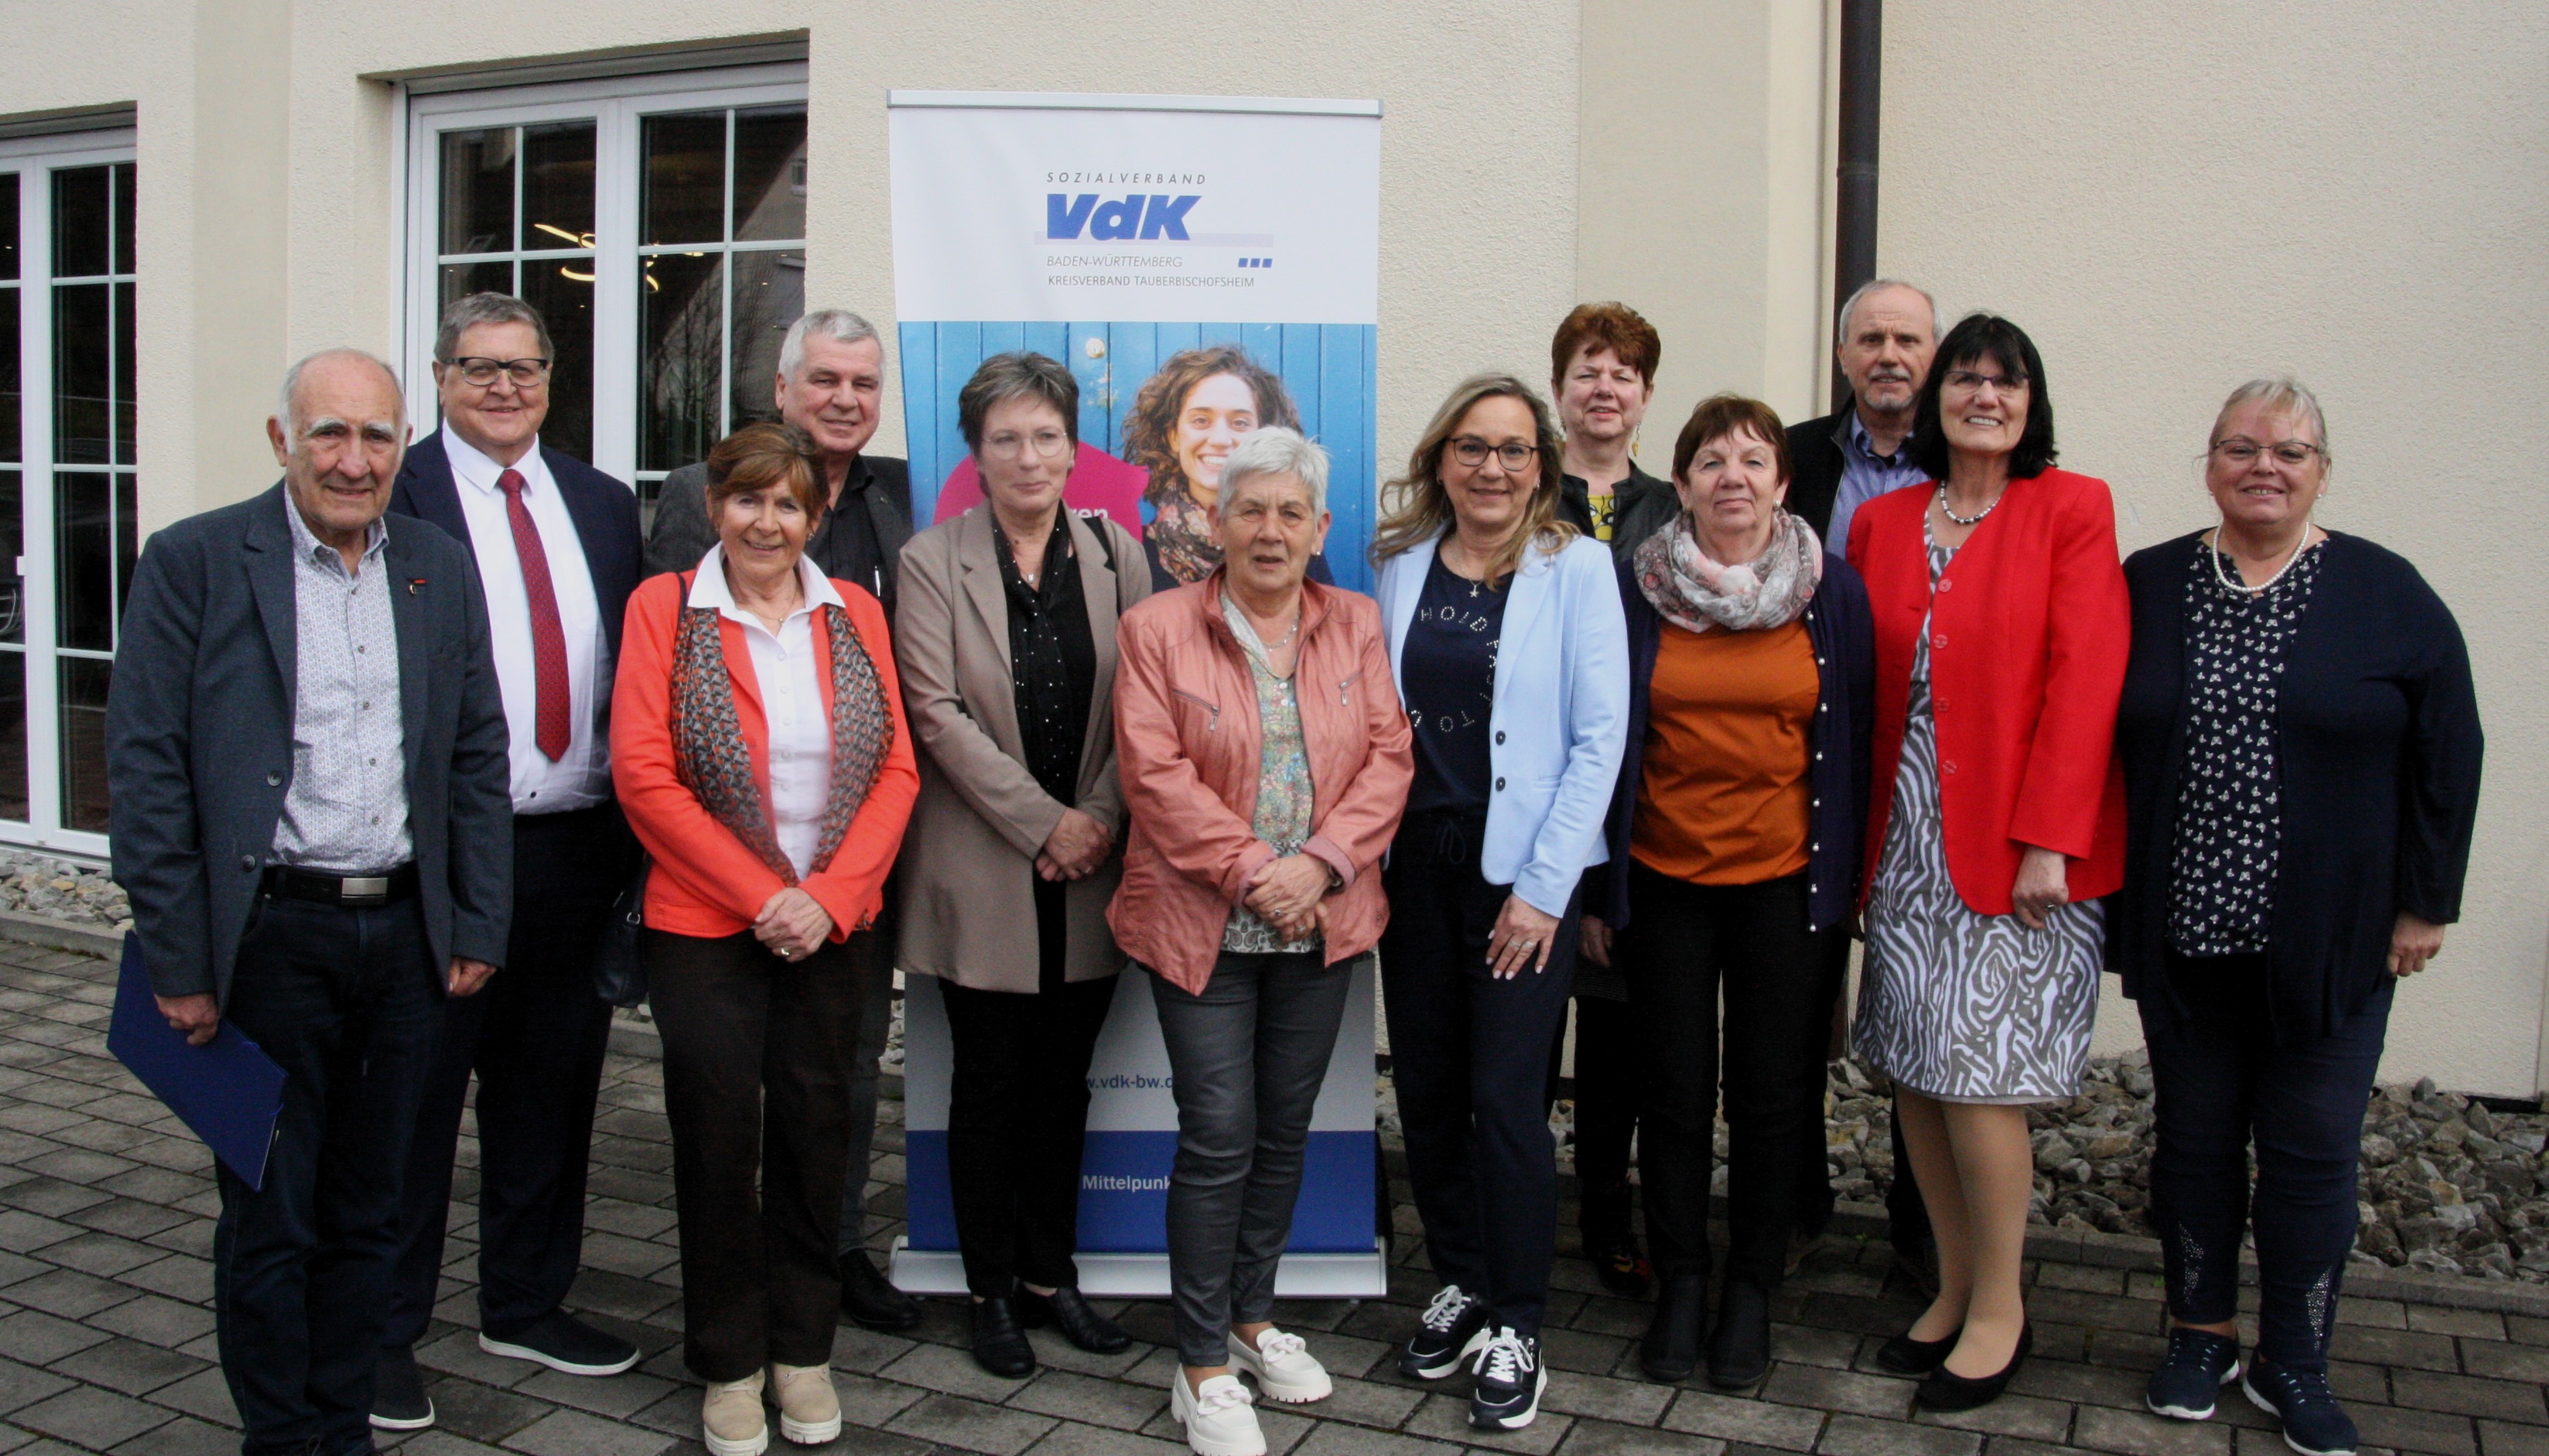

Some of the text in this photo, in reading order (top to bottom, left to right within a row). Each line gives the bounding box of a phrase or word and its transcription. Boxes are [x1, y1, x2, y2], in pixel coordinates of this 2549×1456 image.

[1046, 172, 1206, 184] SOZIALVERBAND
[1047, 194, 1202, 240] VdK
[1046, 253, 1183, 268] BADEN-WÜRTTEMBERG
[1048, 275, 1255, 288] KREISVERBAND TAUBERBISCHOFSHEIM
